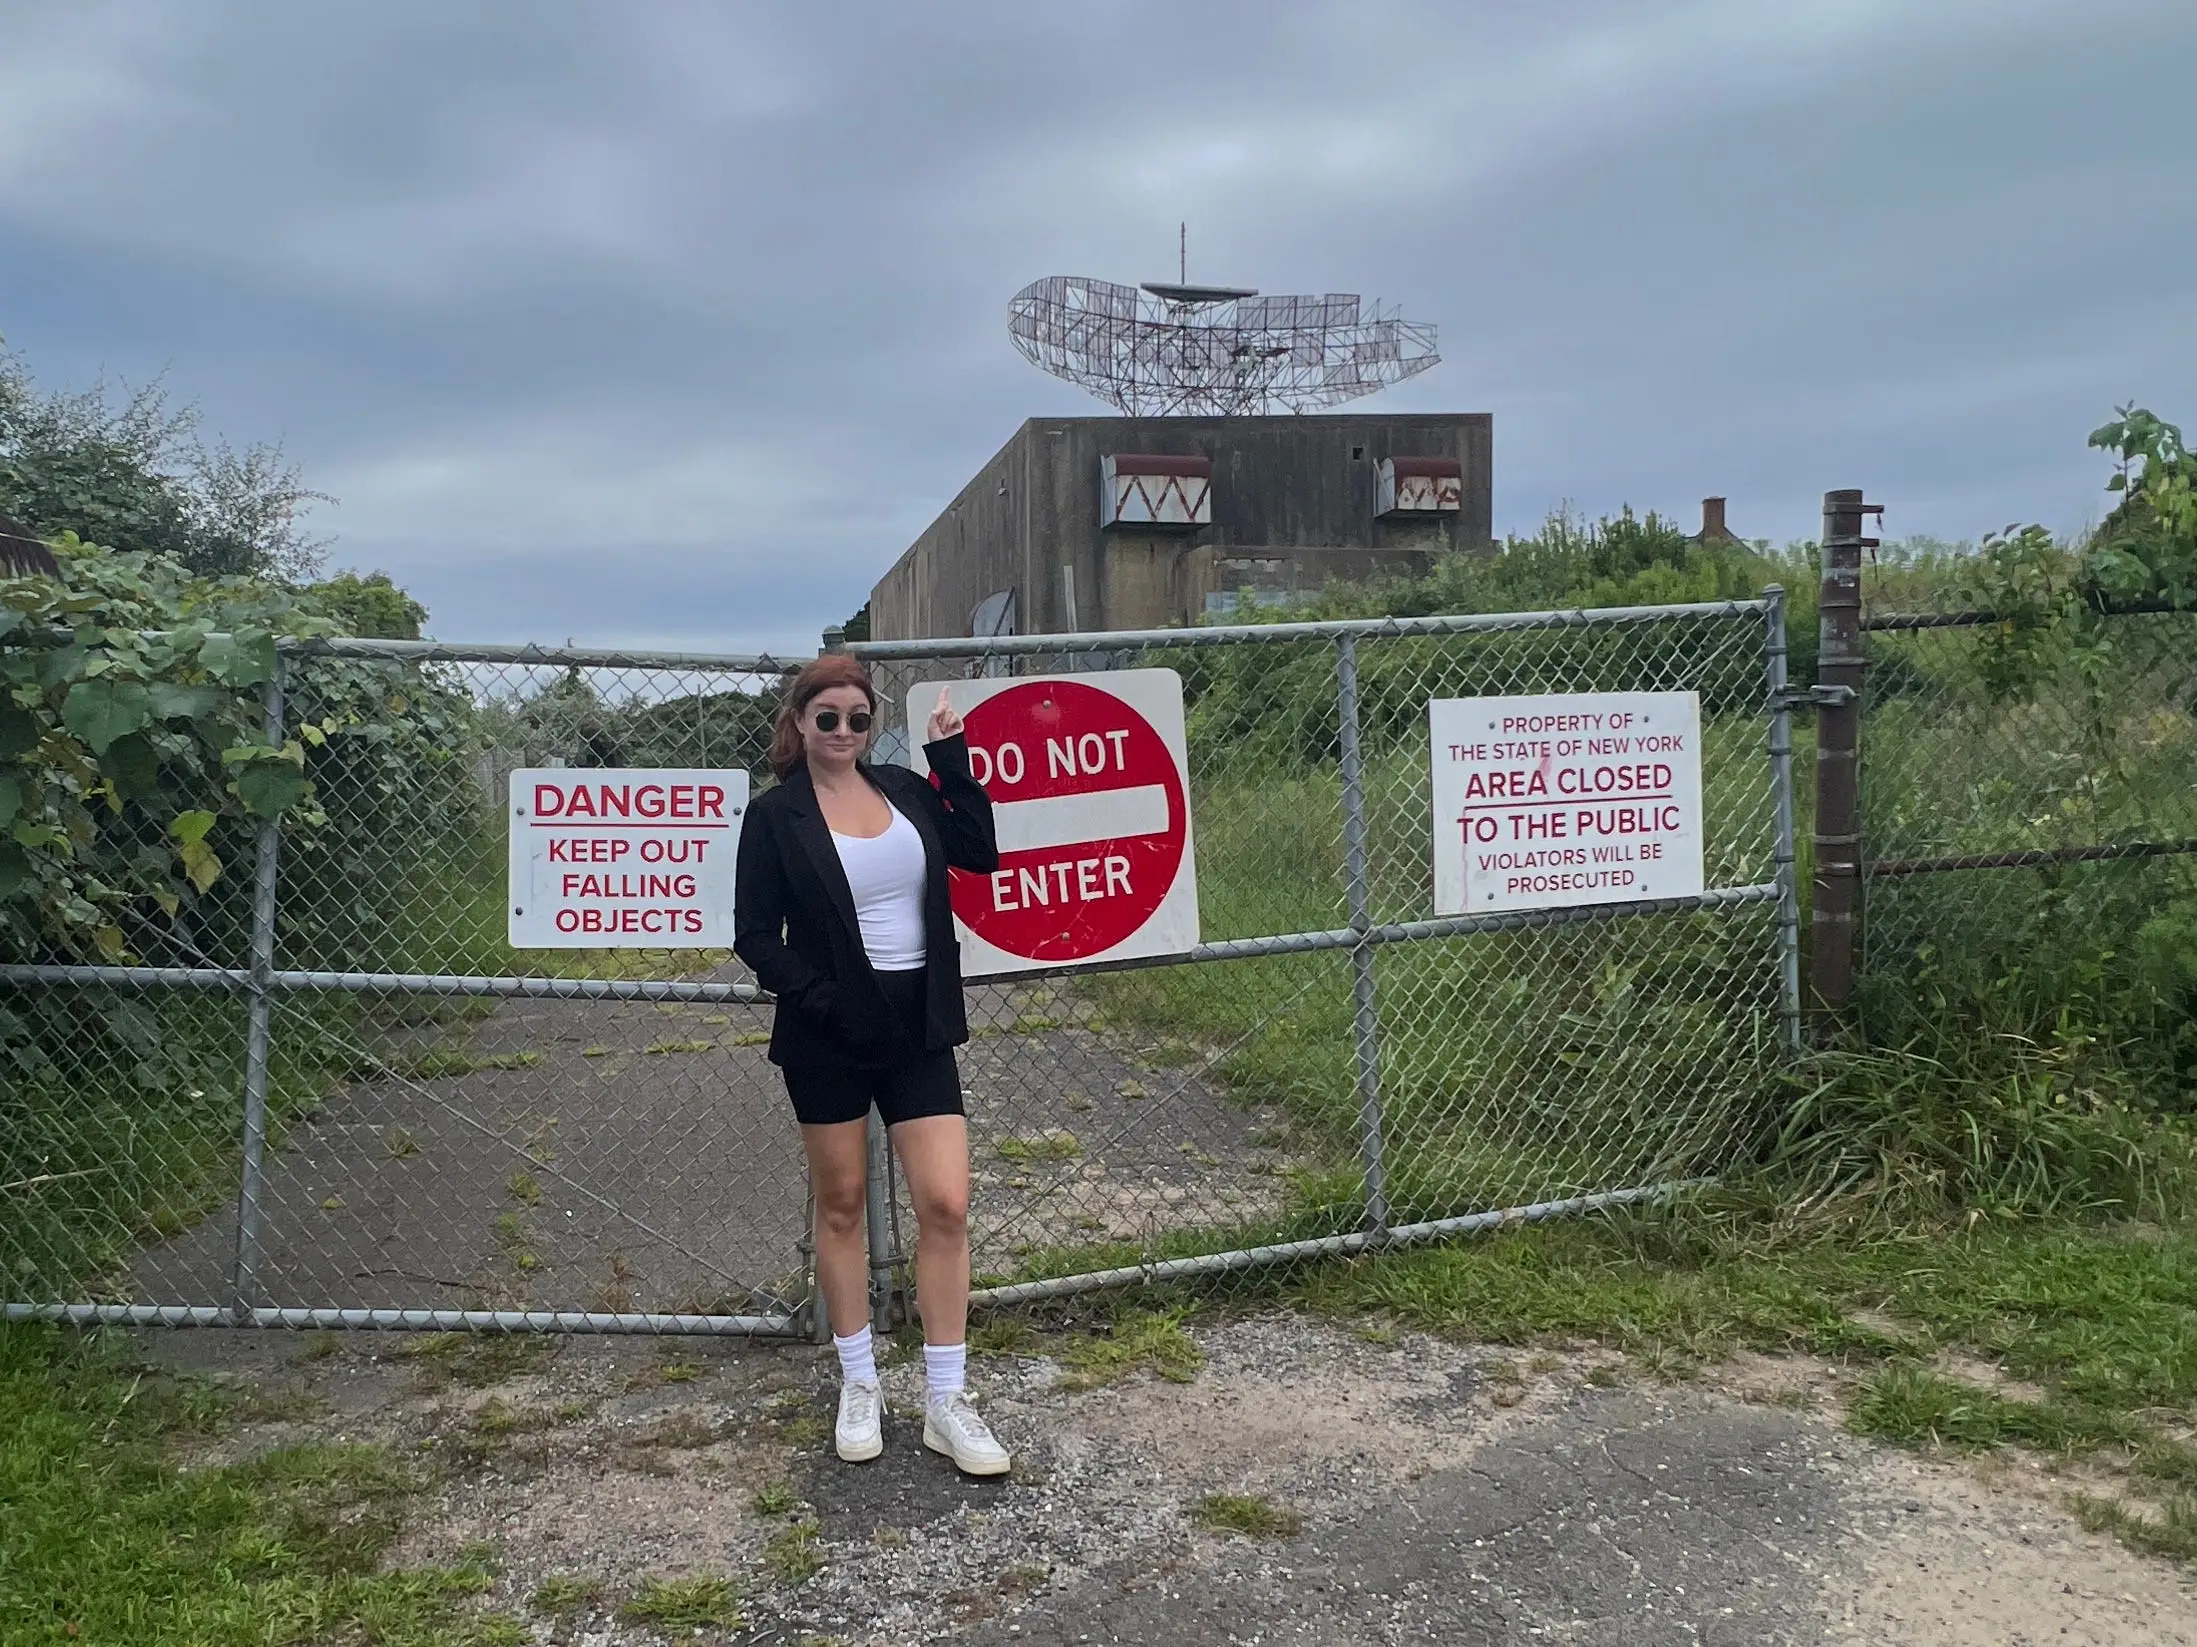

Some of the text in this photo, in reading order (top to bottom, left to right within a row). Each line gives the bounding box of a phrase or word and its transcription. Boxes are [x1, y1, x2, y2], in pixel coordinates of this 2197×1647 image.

[1503, 713, 1633, 734] PROPERTY OF
[969, 729, 1130, 788] DO NOT
[1449, 735, 1684, 761] THE STATE OF NEW YORK
[1465, 764, 1672, 799] AREA CLOSED
[535, 785, 725, 818] DANGER
[1457, 806, 1680, 844] TO THE PUBLIC
[550, 839, 709, 863] KEEP OUT
[1478, 844, 1662, 871] VIOLATORS WILL BE
[563, 874, 696, 898] FALLING
[991, 855, 1133, 912] ENTER
[1507, 870, 1634, 894] PROSECUTED
[556, 909, 703, 933] OBJECTS
